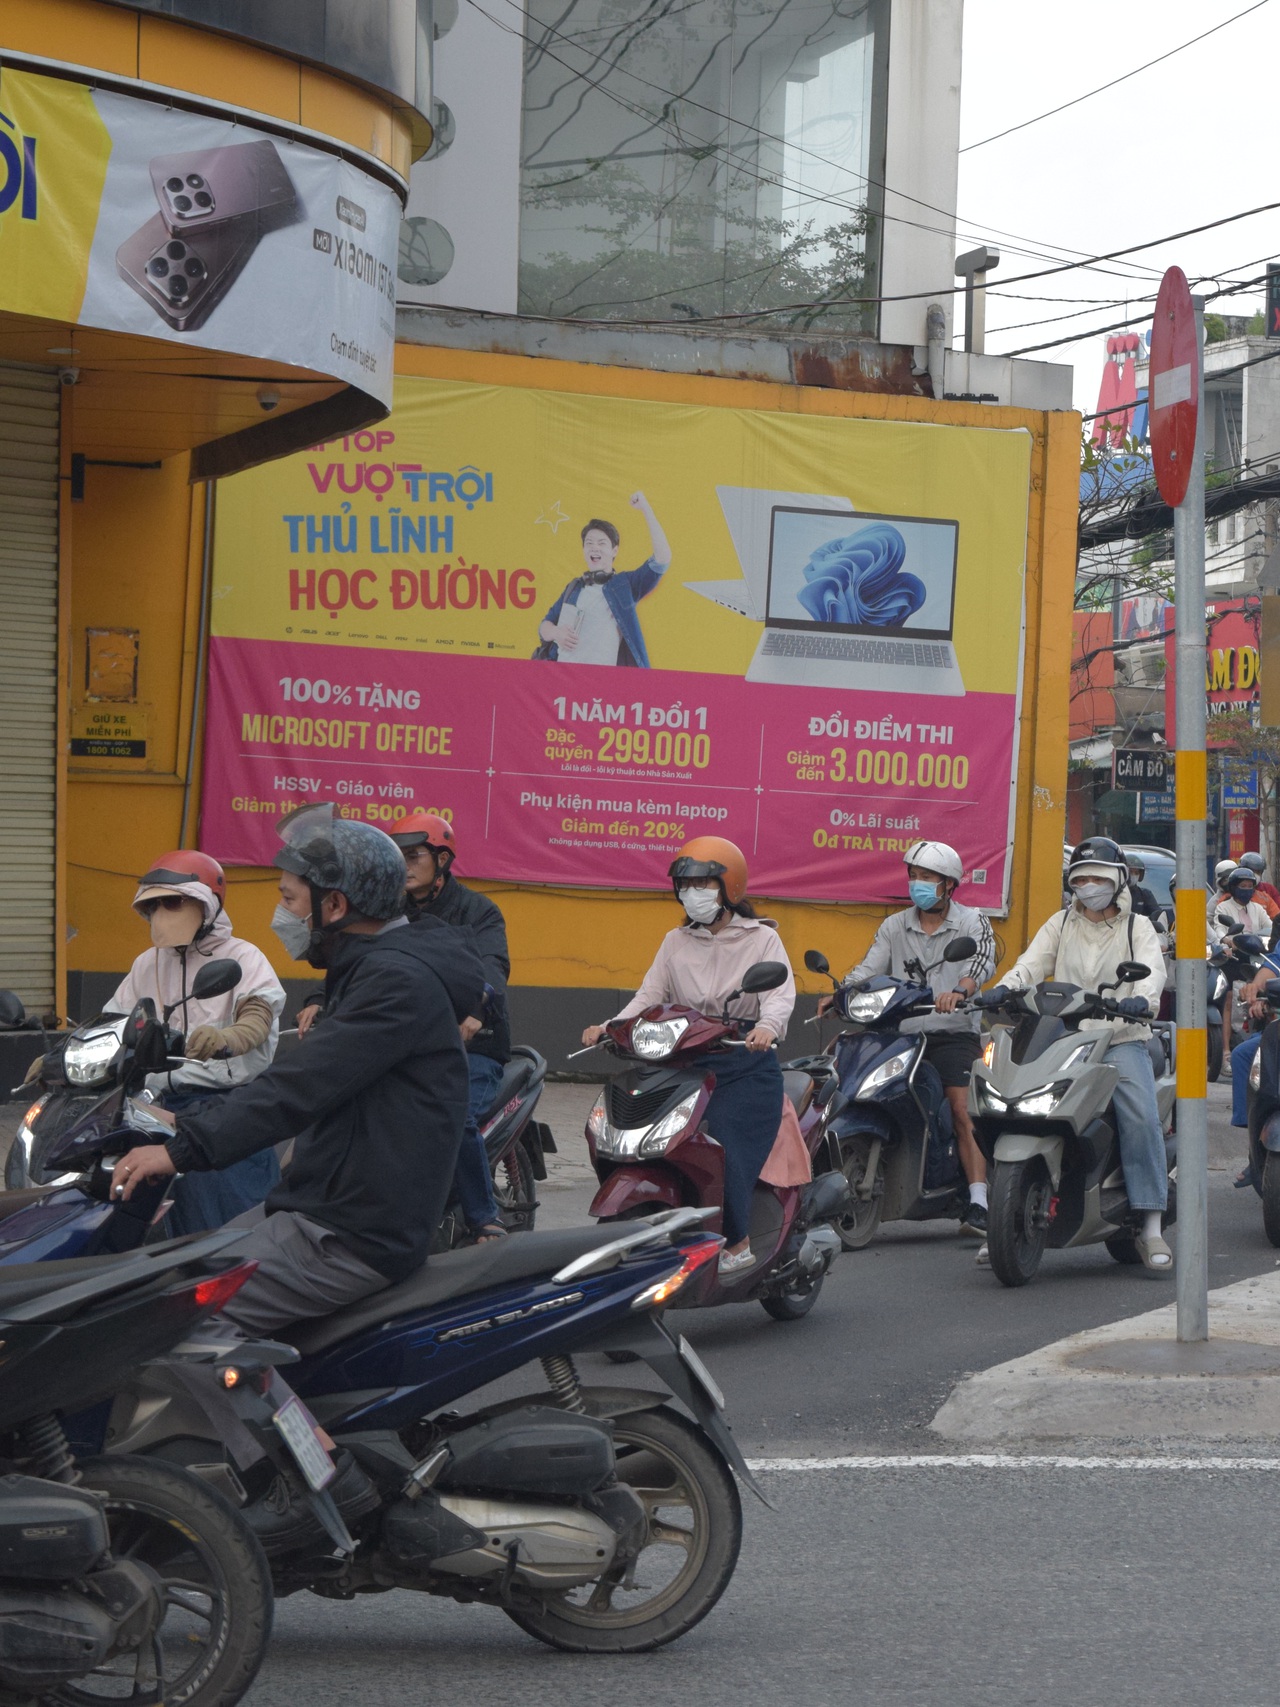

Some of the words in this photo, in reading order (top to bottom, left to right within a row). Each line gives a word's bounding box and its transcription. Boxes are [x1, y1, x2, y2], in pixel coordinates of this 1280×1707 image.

[307, 461, 422, 502] VƯỢT
[402, 465, 493, 510] TRỘI
[283, 502, 357, 553] THỦ
[370, 507, 454, 553] LĨNH
[289, 568, 378, 619] HỌC
[390, 556, 537, 610] ĐƯỜNG
[279, 677, 352, 705] 100%
[355, 682, 421, 712] TẶNG
[113, 715, 127, 723] XE
[553, 696, 567, 720] 1
[571, 698, 625, 724] NĂM
[630, 702, 643, 725] 1
[648, 701, 690, 729] ĐỔI
[694, 707, 708, 730] 1
[241, 713, 371, 750] MICROSOFT
[376, 723, 453, 755] OFFICE
[545, 728, 576, 746] Đặc
[808, 711, 849, 738] ĐỔI
[854, 714, 912, 742] ĐIỂM
[916, 724, 954, 745] THI
[86, 746, 108, 754] 1800
[111, 747, 131, 755] 1062
[544, 744, 593, 762] quyền
[597, 727, 711, 768] 299.000
[787, 750, 825, 766] Giảm
[796, 766, 825, 781] đến
[830, 747, 969, 789] 3.000.000
[1118, 752, 1143, 777] CẦM
[1147, 754, 1163, 777] ĐỒ
[273, 776, 322, 792] HSSV
[335, 780, 374, 797] Giáo
[378, 783, 414, 799] viên
[231, 797, 276, 813] Giảm
[337, 803, 361, 820] ến
[520, 791, 552, 813] Phụ
[557, 794, 593, 814] kiện
[597, 800, 633, 814] mua
[637, 799, 671, 816] kèm
[675, 802, 728, 822] laptop
[829, 808, 855, 826] 0%
[859, 813, 881, 829] Lãi
[885, 814, 920, 830] suất
[549, 837, 572, 847] Không
[573, 838, 583, 847] áp
[584, 839, 602, 849] dụng
[561, 818, 604, 835] Giảm
[608, 820, 640, 836] đến
[643, 821, 685, 840] 20%
[813, 829, 838, 849] 0đ
[439, 1319, 493, 1342] AIR
[495, 1291, 584, 1324] BLADE
